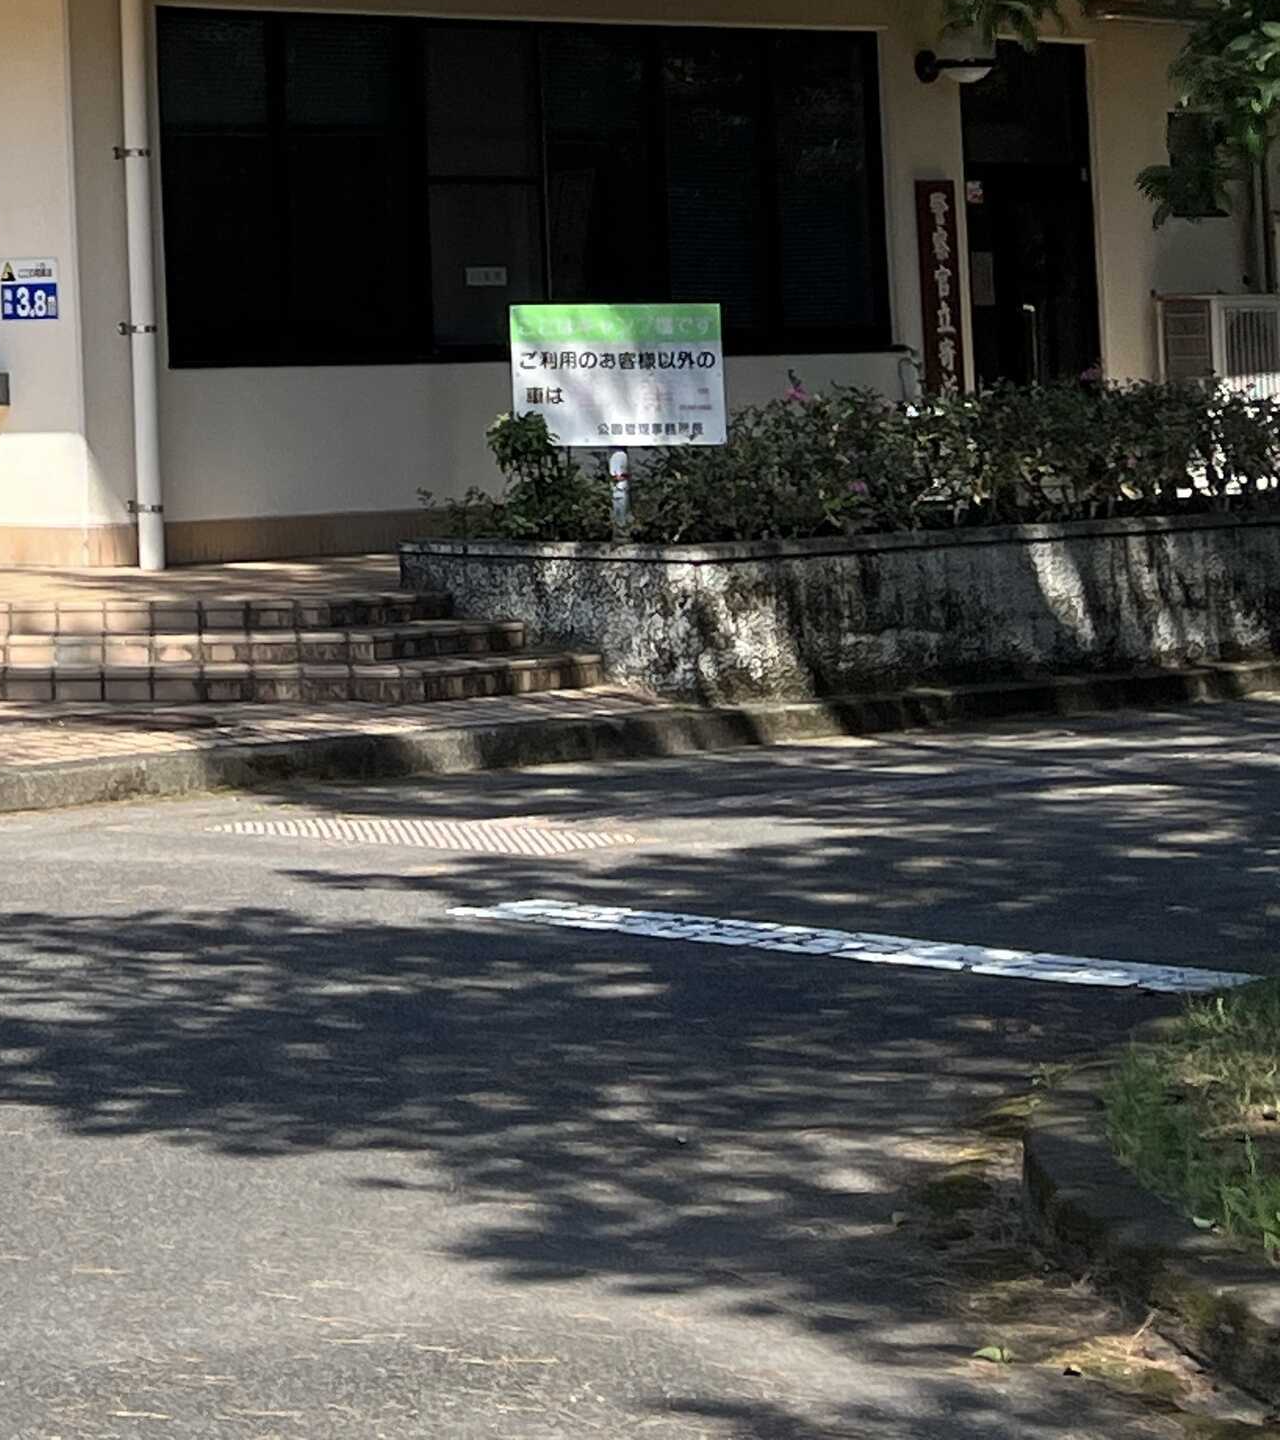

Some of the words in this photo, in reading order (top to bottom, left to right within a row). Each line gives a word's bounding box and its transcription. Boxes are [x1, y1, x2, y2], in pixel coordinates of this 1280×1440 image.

[519, 350, 716, 371] ご利用のお客様以外の
[526, 386, 564, 405] 車は
